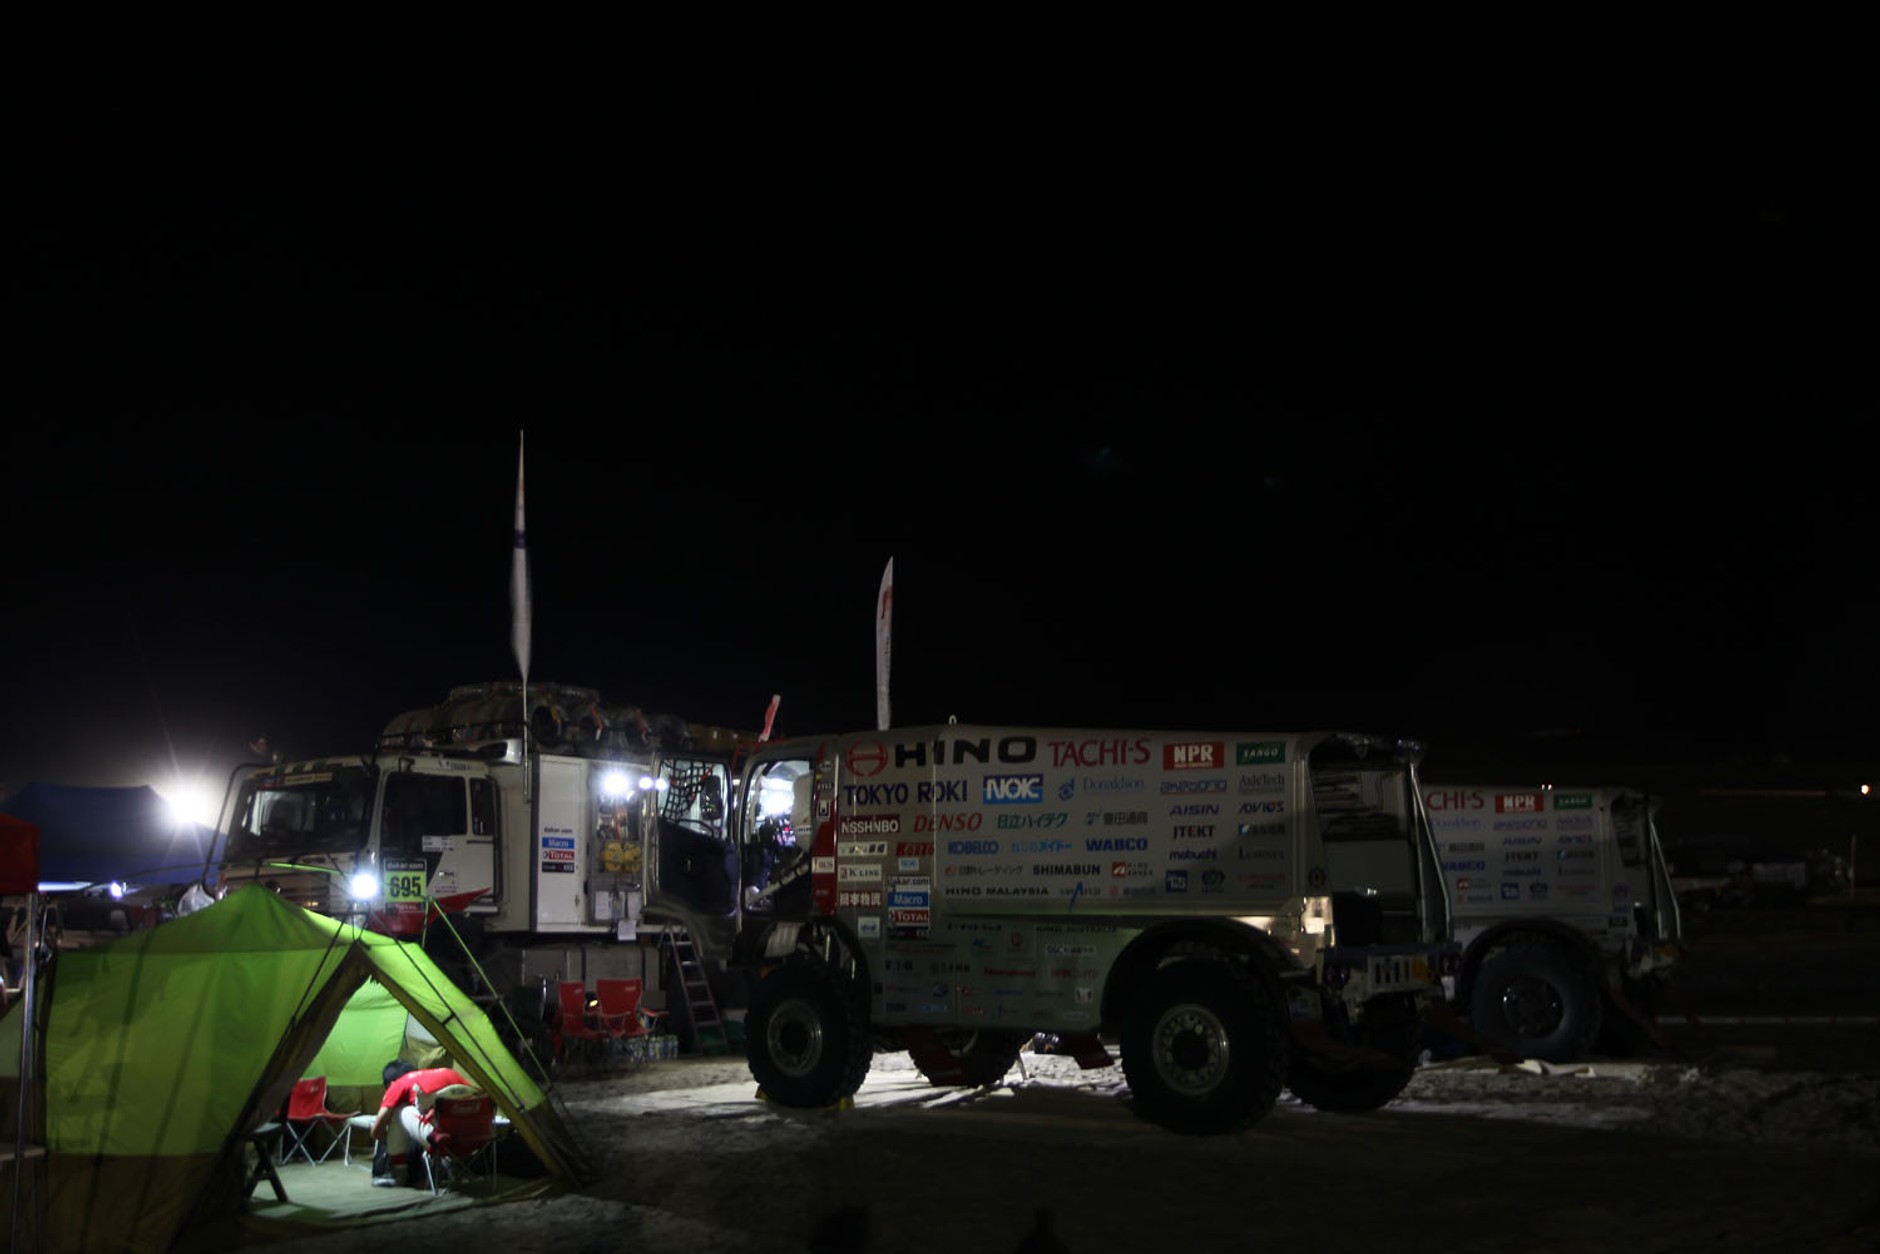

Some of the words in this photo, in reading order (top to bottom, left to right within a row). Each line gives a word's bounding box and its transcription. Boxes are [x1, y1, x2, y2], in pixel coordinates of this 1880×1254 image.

[895, 736, 1036, 767] HINO
[1049, 738, 1150, 767] TACHI-S
[1173, 744, 1214, 763] NPR
[1083, 776, 1145, 792] Donaldson
[1240, 774, 1285, 787] AxleTech
[844, 783, 908, 806] TOKYO
[918, 780, 967, 803] ROKI
[986, 777, 1040, 800] NOK
[1169, 804, 1219, 816] AISIN
[914, 812, 983, 833] DENSO
[997, 813, 1069, 829] 日立ハイテク
[1174, 825, 1216, 839] JTEKT
[948, 840, 999, 855] KOBELCO
[1086, 837, 1148, 851] WABCO
[550, 850, 573, 860] TOTAL
[1169, 848, 1216, 861] mabuchi
[1033, 864, 1101, 875] SHIMABUN
[390, 875, 421, 897] 695
[987, 885, 1049, 895] MALAYSIA
[894, 894, 923, 905] Macro
[897, 911, 929, 922] TOTAL
